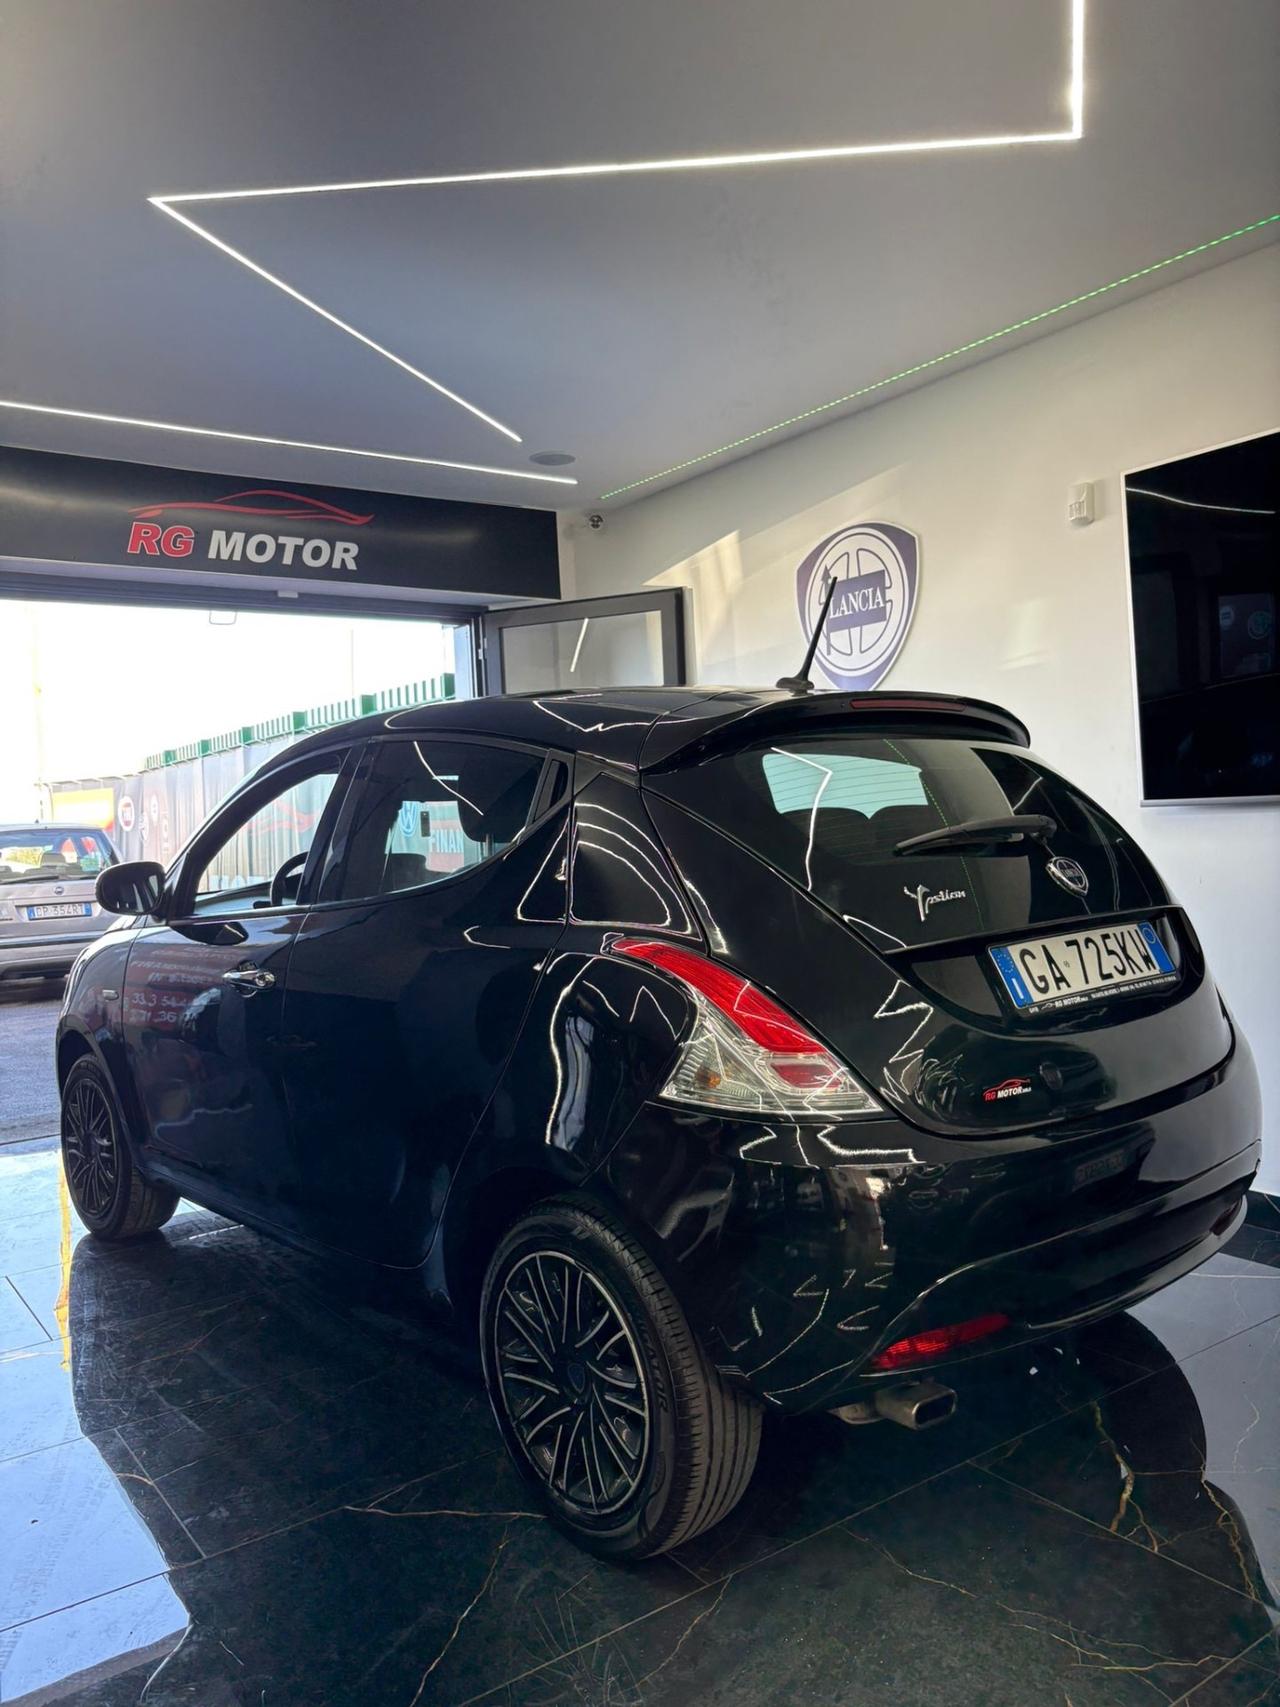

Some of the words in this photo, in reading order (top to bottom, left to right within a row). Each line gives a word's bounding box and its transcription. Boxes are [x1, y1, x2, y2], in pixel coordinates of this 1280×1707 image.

[127, 521, 195, 558] RG
[207, 530, 360, 571] MOTOR
[829, 586, 885, 619] LANCIA
[903, 884, 966, 922] Ypsilon
[1019, 944, 1072, 995] GA
[1064, 928, 1157, 985] 725KW
[985, 1091, 997, 1101] RG
[997, 1086, 1023, 1099] MOTOR
